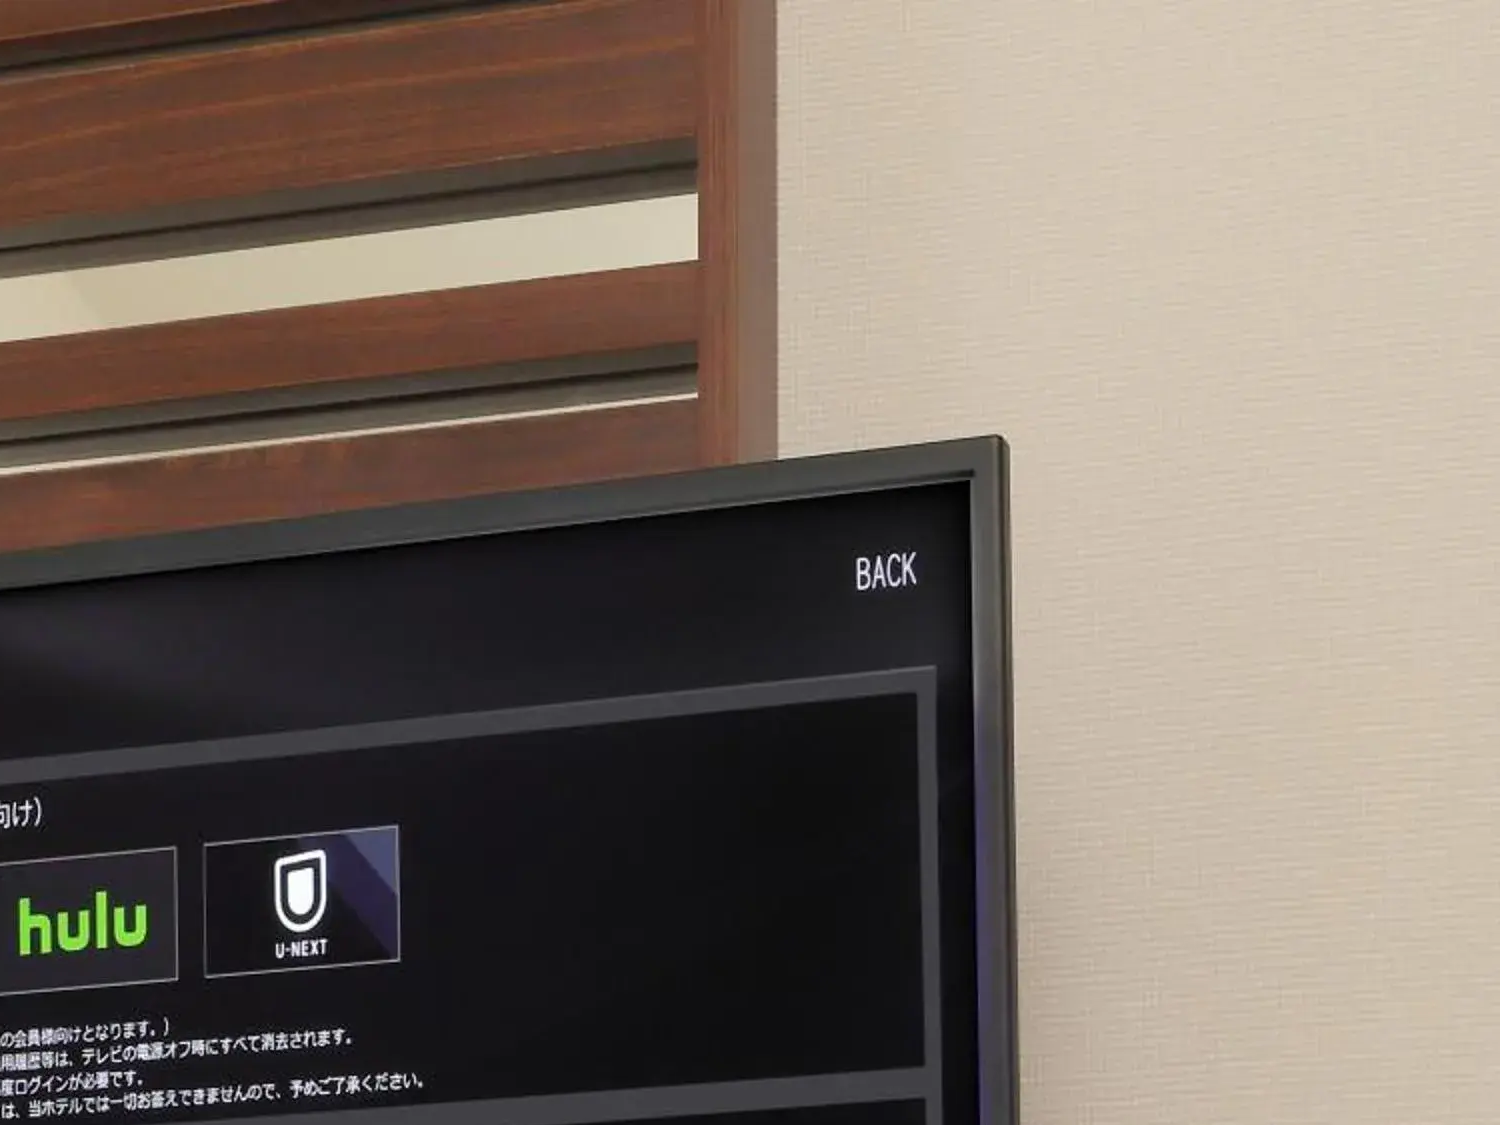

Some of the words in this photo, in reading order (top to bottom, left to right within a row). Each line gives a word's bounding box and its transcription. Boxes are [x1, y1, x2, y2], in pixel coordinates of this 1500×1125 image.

[856, 552, 918, 592] BACK
[18, 891, 148, 957] hulu
[274, 938, 328, 959] U-NEXT
